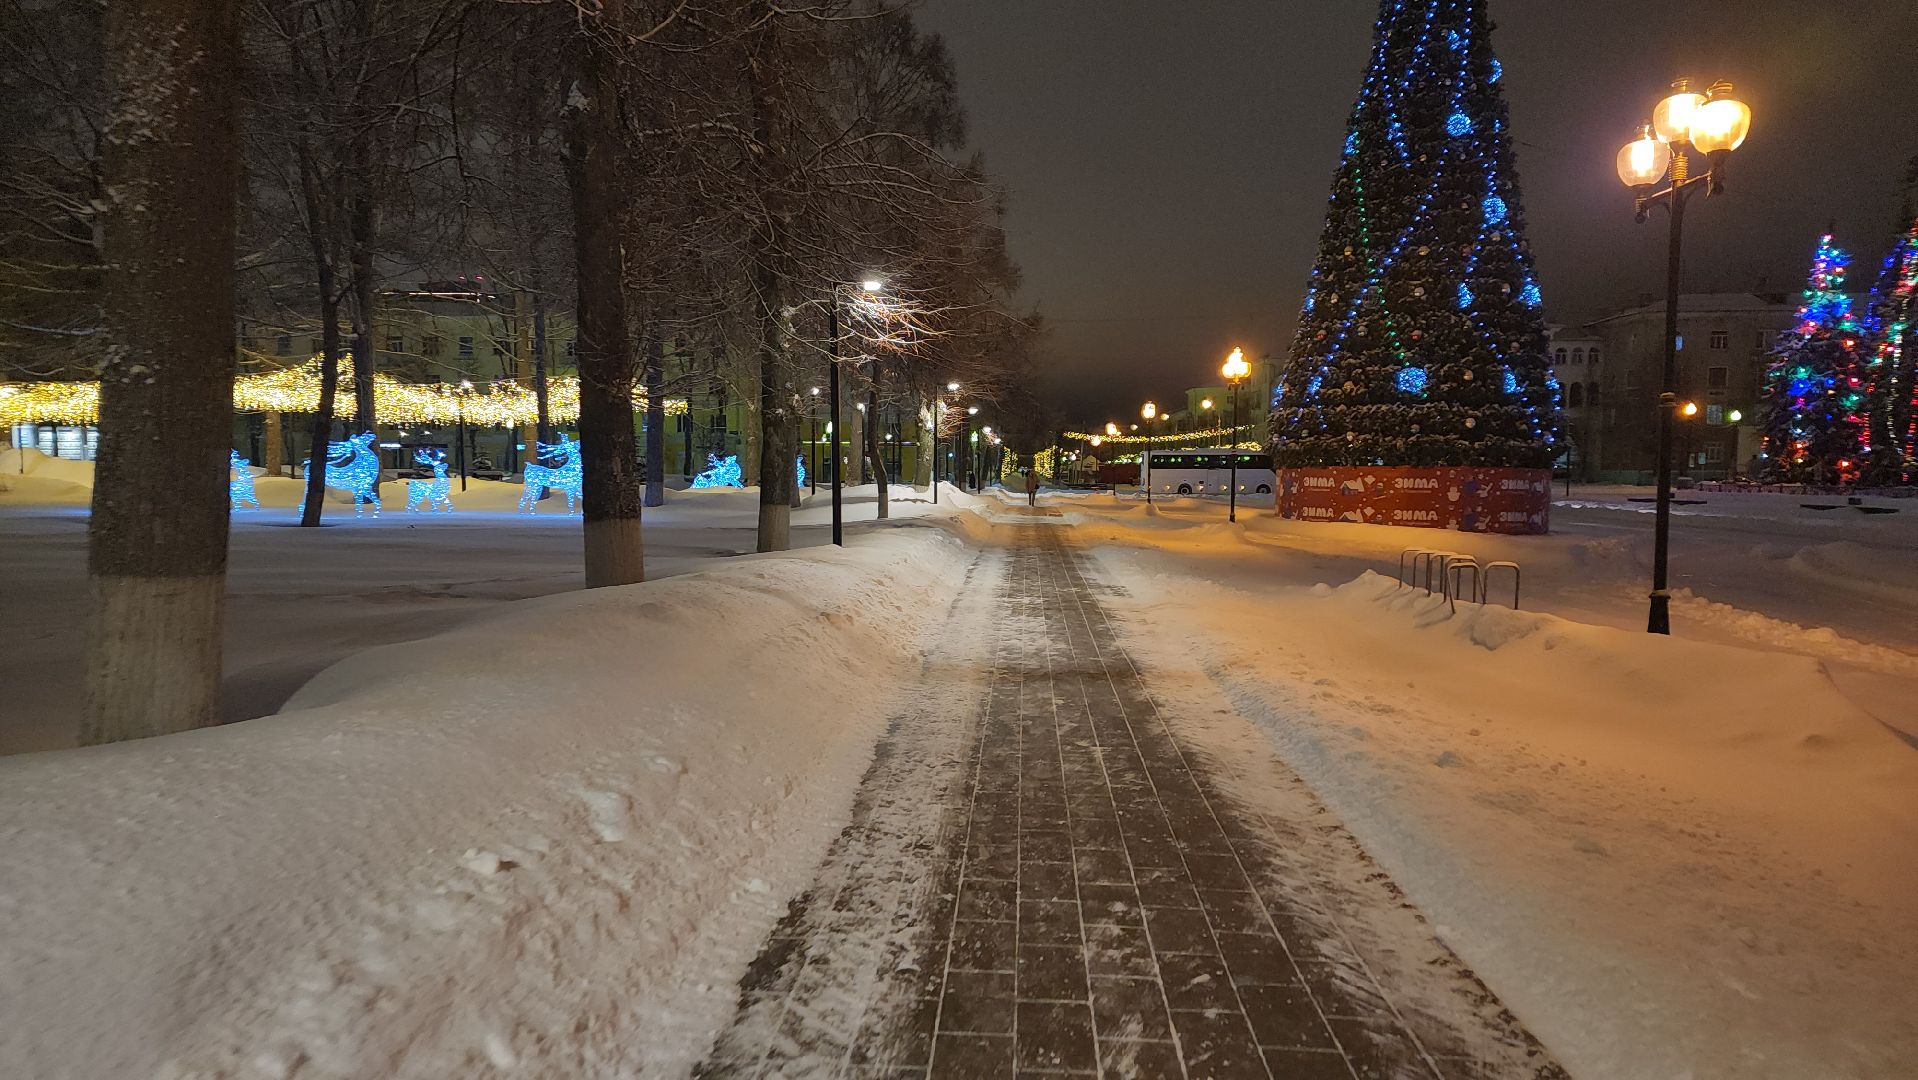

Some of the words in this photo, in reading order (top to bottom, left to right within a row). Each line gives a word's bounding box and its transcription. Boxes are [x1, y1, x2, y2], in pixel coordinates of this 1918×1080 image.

[1303, 476, 1335, 488] ЗИМА
[1394, 477, 1438, 489] ЗИМА
[1501, 479, 1529, 490] ЗИМА
[1302, 506, 1334, 518] ЗИМА
[1393, 509, 1438, 521] ЗИМА
[1499, 511, 1528, 522] ЗИМА
